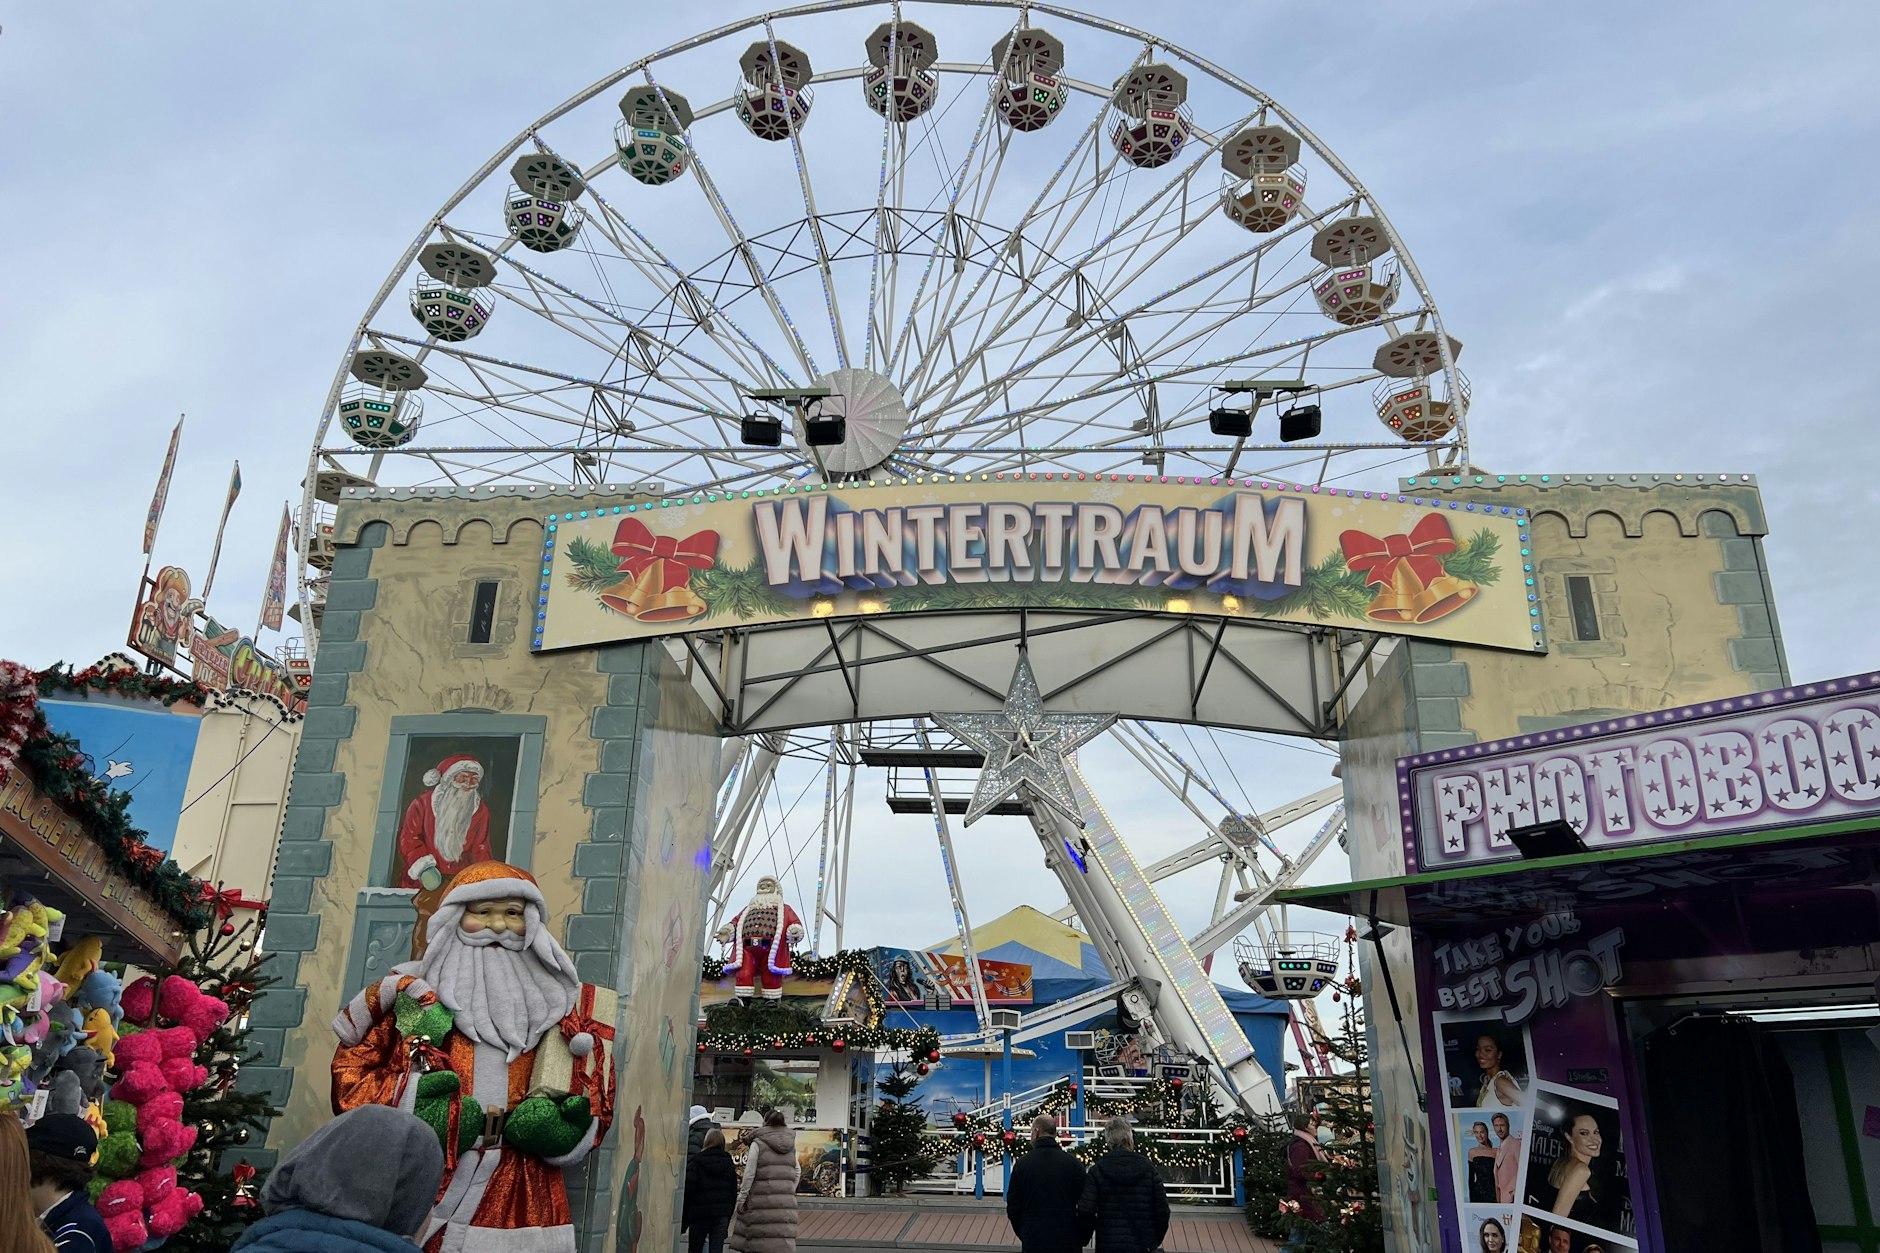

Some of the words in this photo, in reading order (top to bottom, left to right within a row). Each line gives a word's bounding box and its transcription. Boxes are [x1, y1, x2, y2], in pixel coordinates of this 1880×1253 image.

[752, 492, 1306, 592] WINTERTRAUM
[1433, 933, 1503, 975] TAKE
[1504, 911, 1582, 952] YOUR
[1437, 967, 1503, 1009] BEST
[1502, 927, 1625, 1025] SHOT
